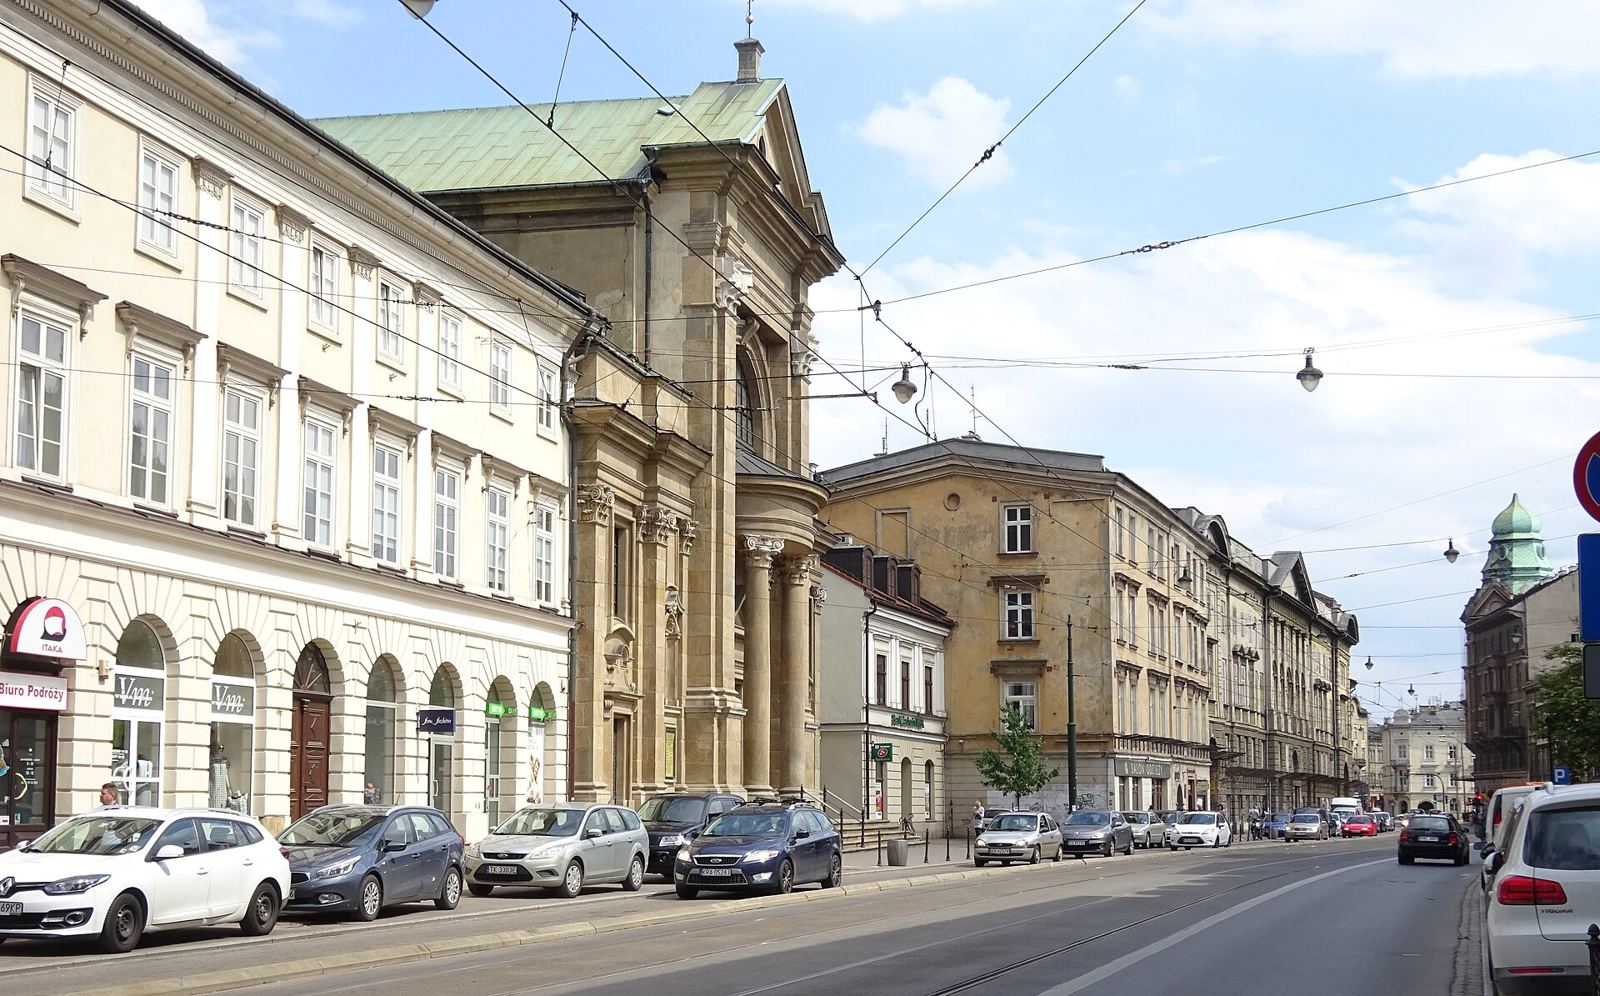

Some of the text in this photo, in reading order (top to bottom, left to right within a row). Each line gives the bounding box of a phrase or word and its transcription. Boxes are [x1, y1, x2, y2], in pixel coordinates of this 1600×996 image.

[42, 643, 63, 654] ITAKA
[0, 683, 64, 702] Biuro Podróży
[1554, 768, 1566, 783] P
